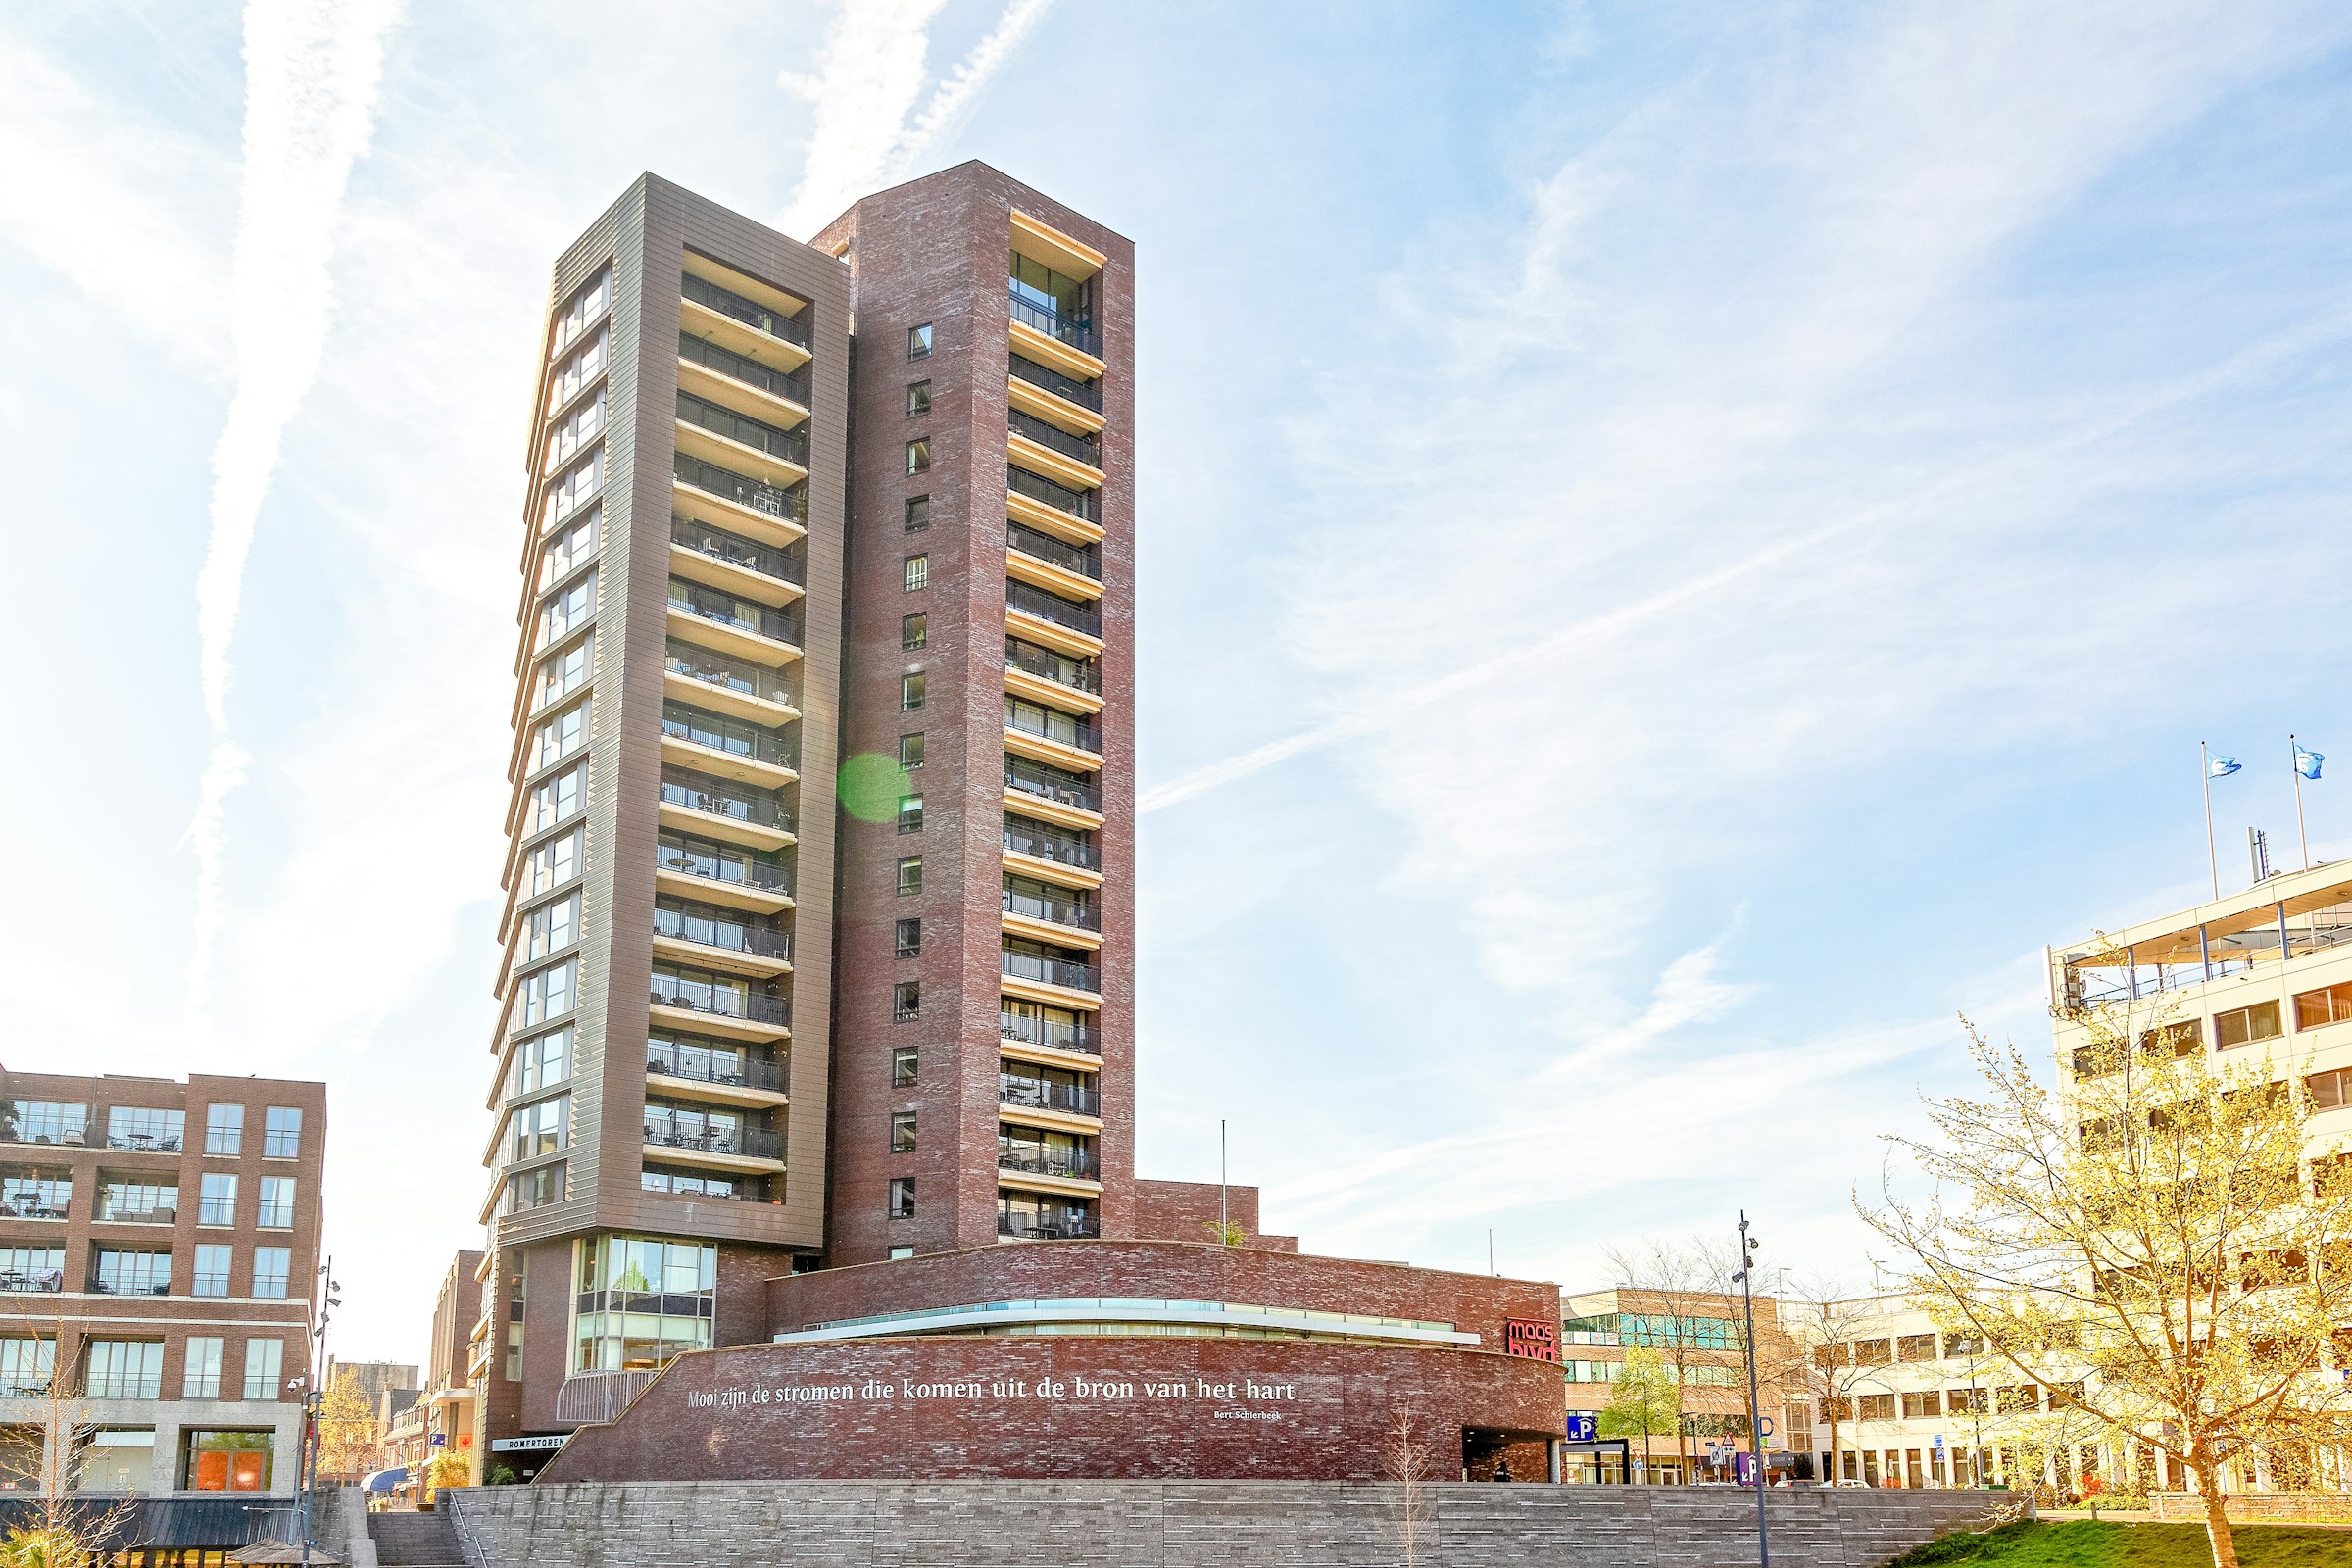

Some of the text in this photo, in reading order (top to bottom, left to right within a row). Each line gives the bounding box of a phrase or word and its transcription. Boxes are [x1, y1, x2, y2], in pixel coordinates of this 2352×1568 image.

[1509, 1321, 1554, 1341] maas
[688, 1377, 1296, 1410] Mooi zijn de stromen die komen uit de bron van het hart
[1214, 1410, 1282, 1420] Bert Schierbeek
[431, 1435, 438, 1444] P
[1580, 1421, 1592, 1439] P
[1748, 1459, 1757, 1482] P
